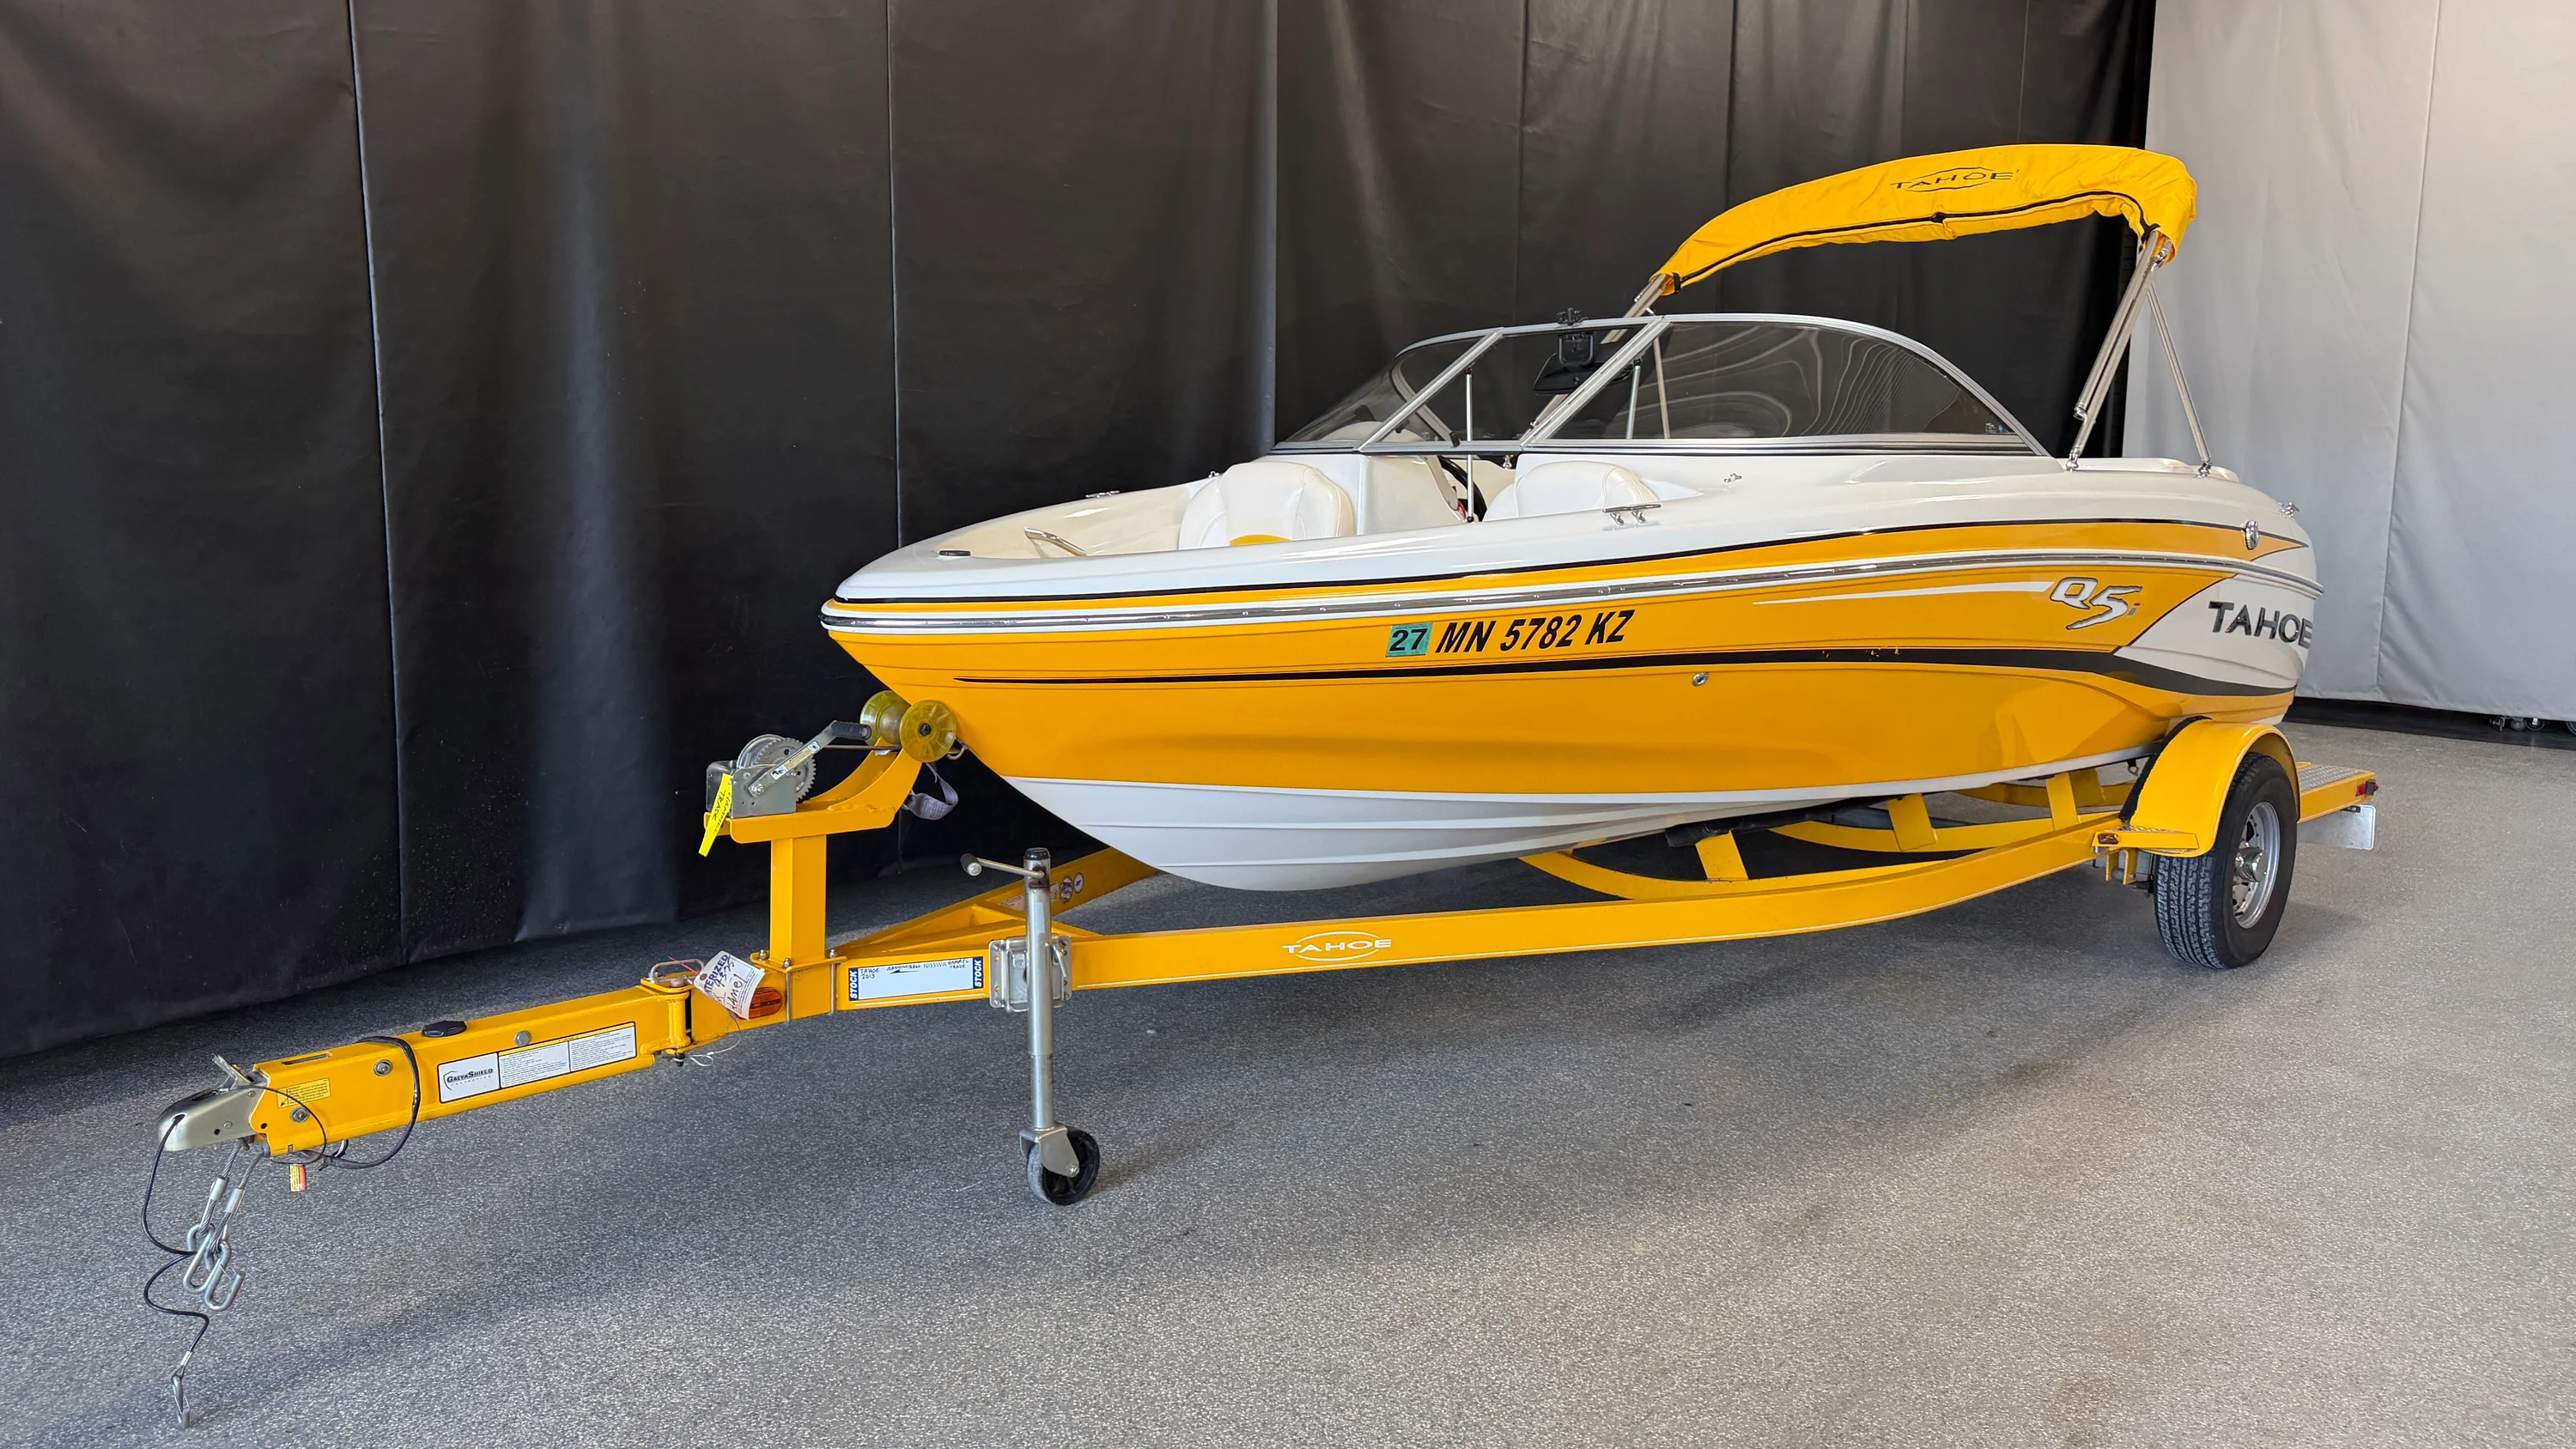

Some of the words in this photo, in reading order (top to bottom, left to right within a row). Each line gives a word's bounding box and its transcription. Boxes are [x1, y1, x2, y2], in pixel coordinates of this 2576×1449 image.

[1890, 172, 2014, 190] TAHOE
[1435, 620, 1497, 654] MN
[1500, 614, 1583, 652] 5782
[1585, 609, 1636, 646] KZ
[2208, 600, 2314, 650] TAHOE
[1389, 627, 1428, 652] 27
[1282, 938, 1392, 954] TAHOE
[849, 970, 858, 999] STOCK
[974, 959, 982, 987] STOCK
